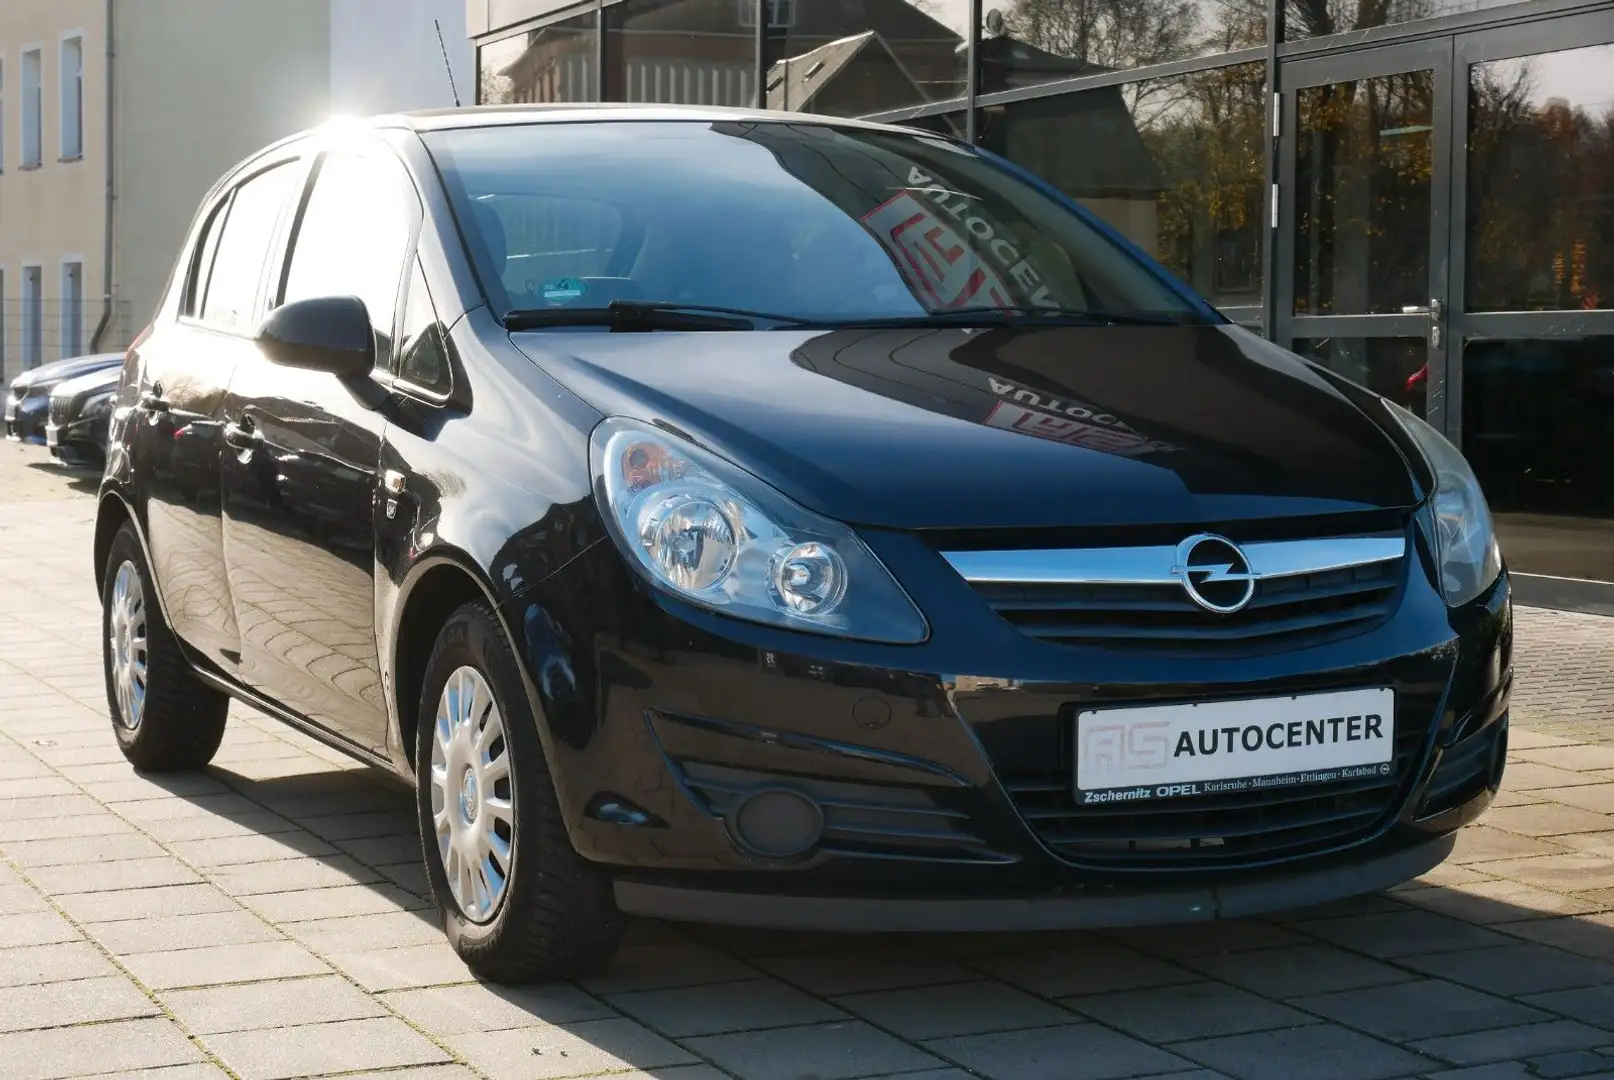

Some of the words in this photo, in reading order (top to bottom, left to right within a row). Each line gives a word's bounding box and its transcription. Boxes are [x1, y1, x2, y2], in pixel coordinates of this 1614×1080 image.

[1173, 714, 1383, 757] AUTOCENTER
[1084, 788, 1151, 803] Zschernitz
[1156, 784, 1201, 797] OPEL
[1204, 780, 1247, 792] Karlsruhe
[1252, 775, 1297, 787] Mannheim
